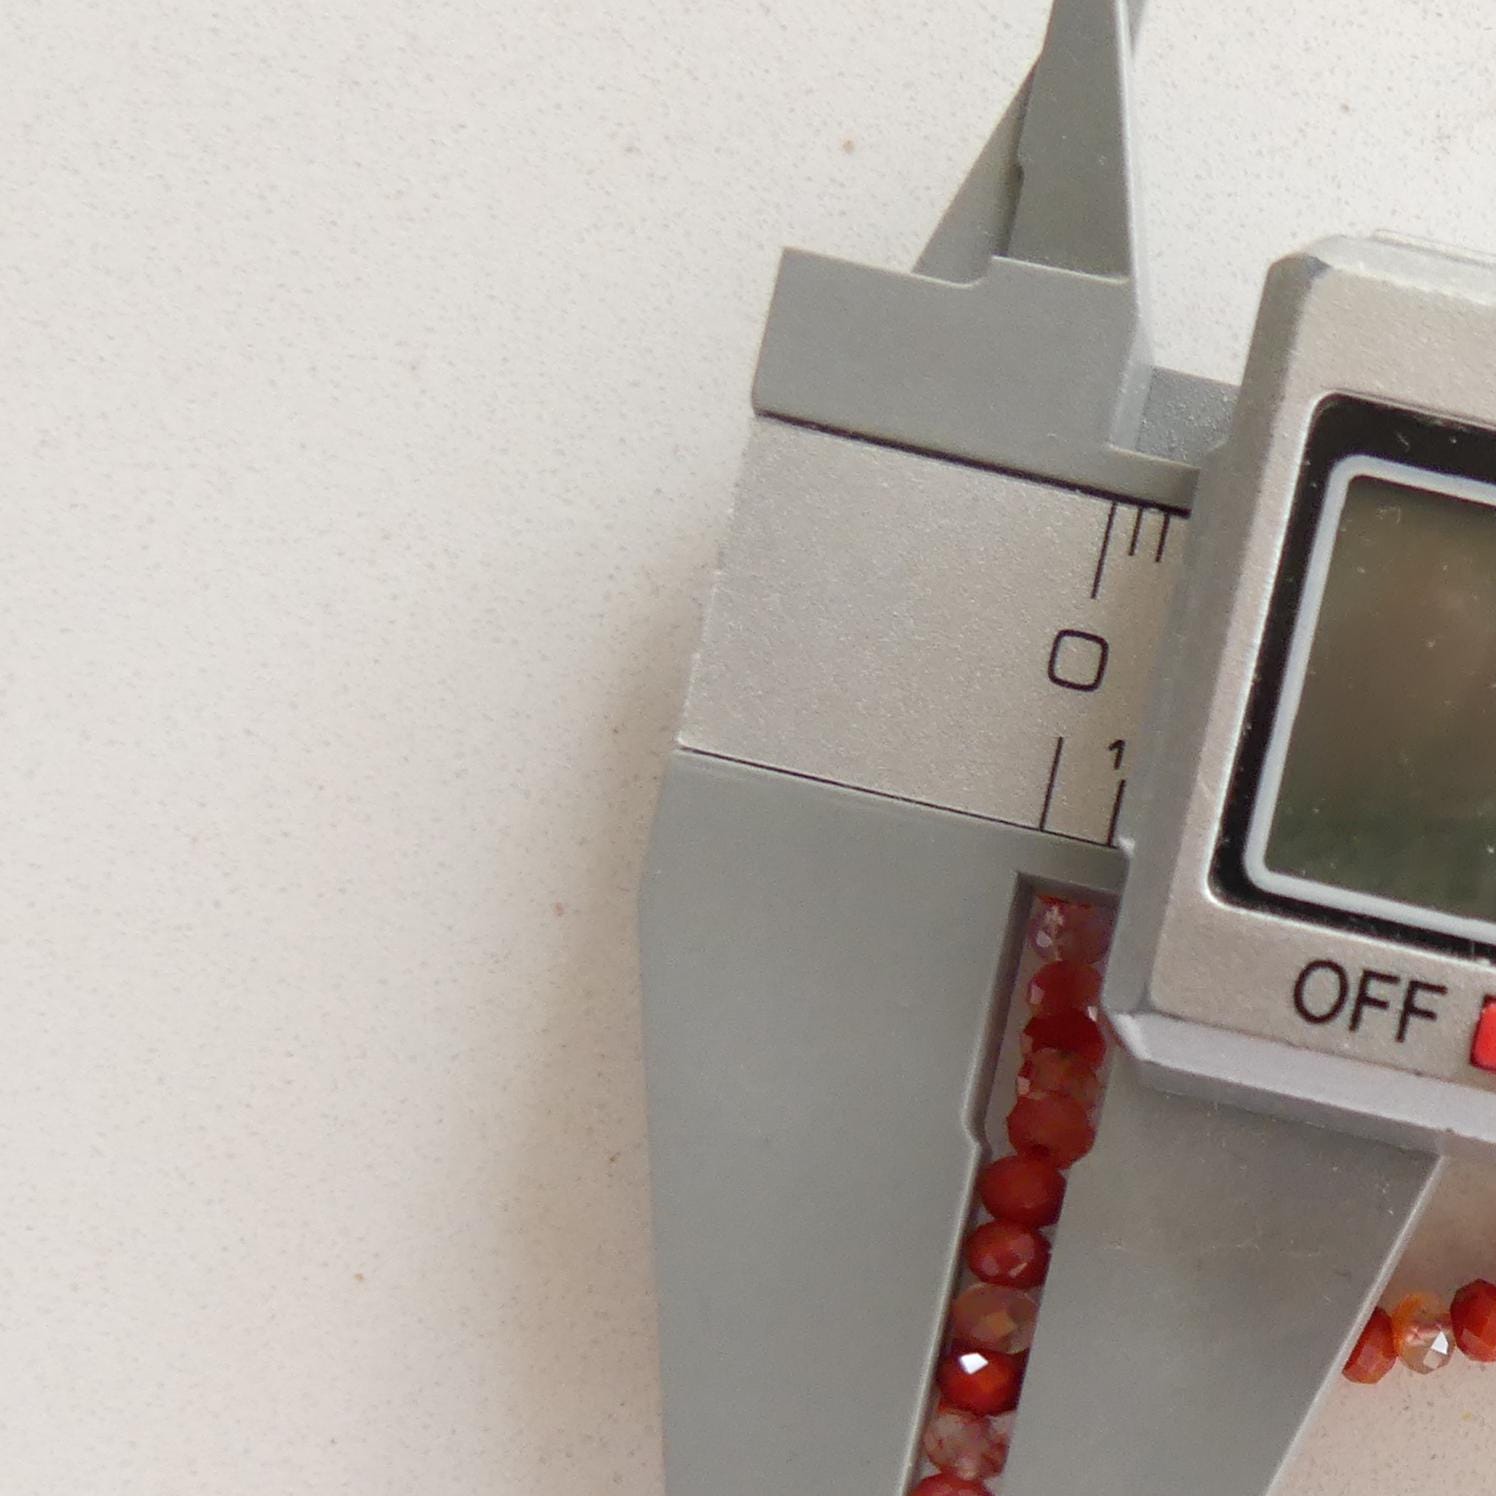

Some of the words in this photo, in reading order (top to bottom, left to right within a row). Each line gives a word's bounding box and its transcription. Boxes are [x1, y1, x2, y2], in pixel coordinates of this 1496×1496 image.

[1047, 628, 1110, 693] 0
[1107, 738, 1126, 770] 1
[1293, 959, 1448, 1042] OFF
